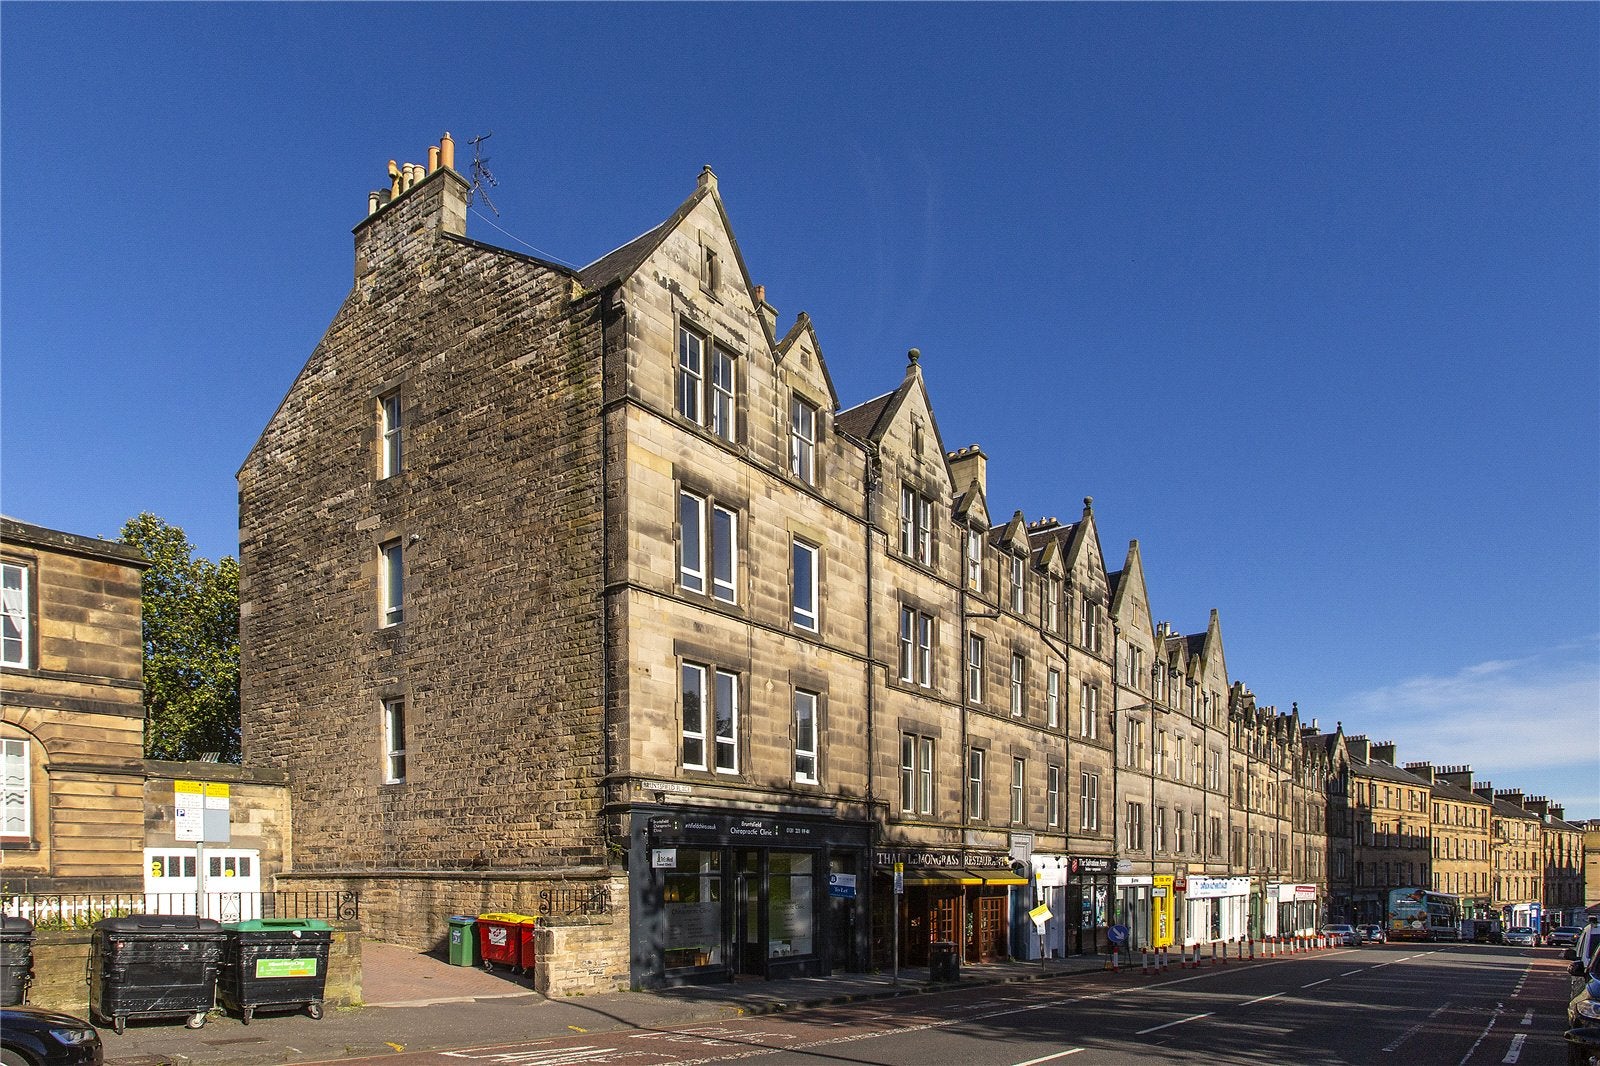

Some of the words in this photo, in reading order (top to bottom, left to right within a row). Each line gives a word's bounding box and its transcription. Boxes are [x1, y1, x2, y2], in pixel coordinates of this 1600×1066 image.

[741, 820, 762, 828] Bruntsfield
[730, 826, 758, 836] Chiropractic
[759, 828, 773, 836] Clinic
[876, 852, 901, 864] THAI
[907, 854, 959, 866] LEMONGRASS
